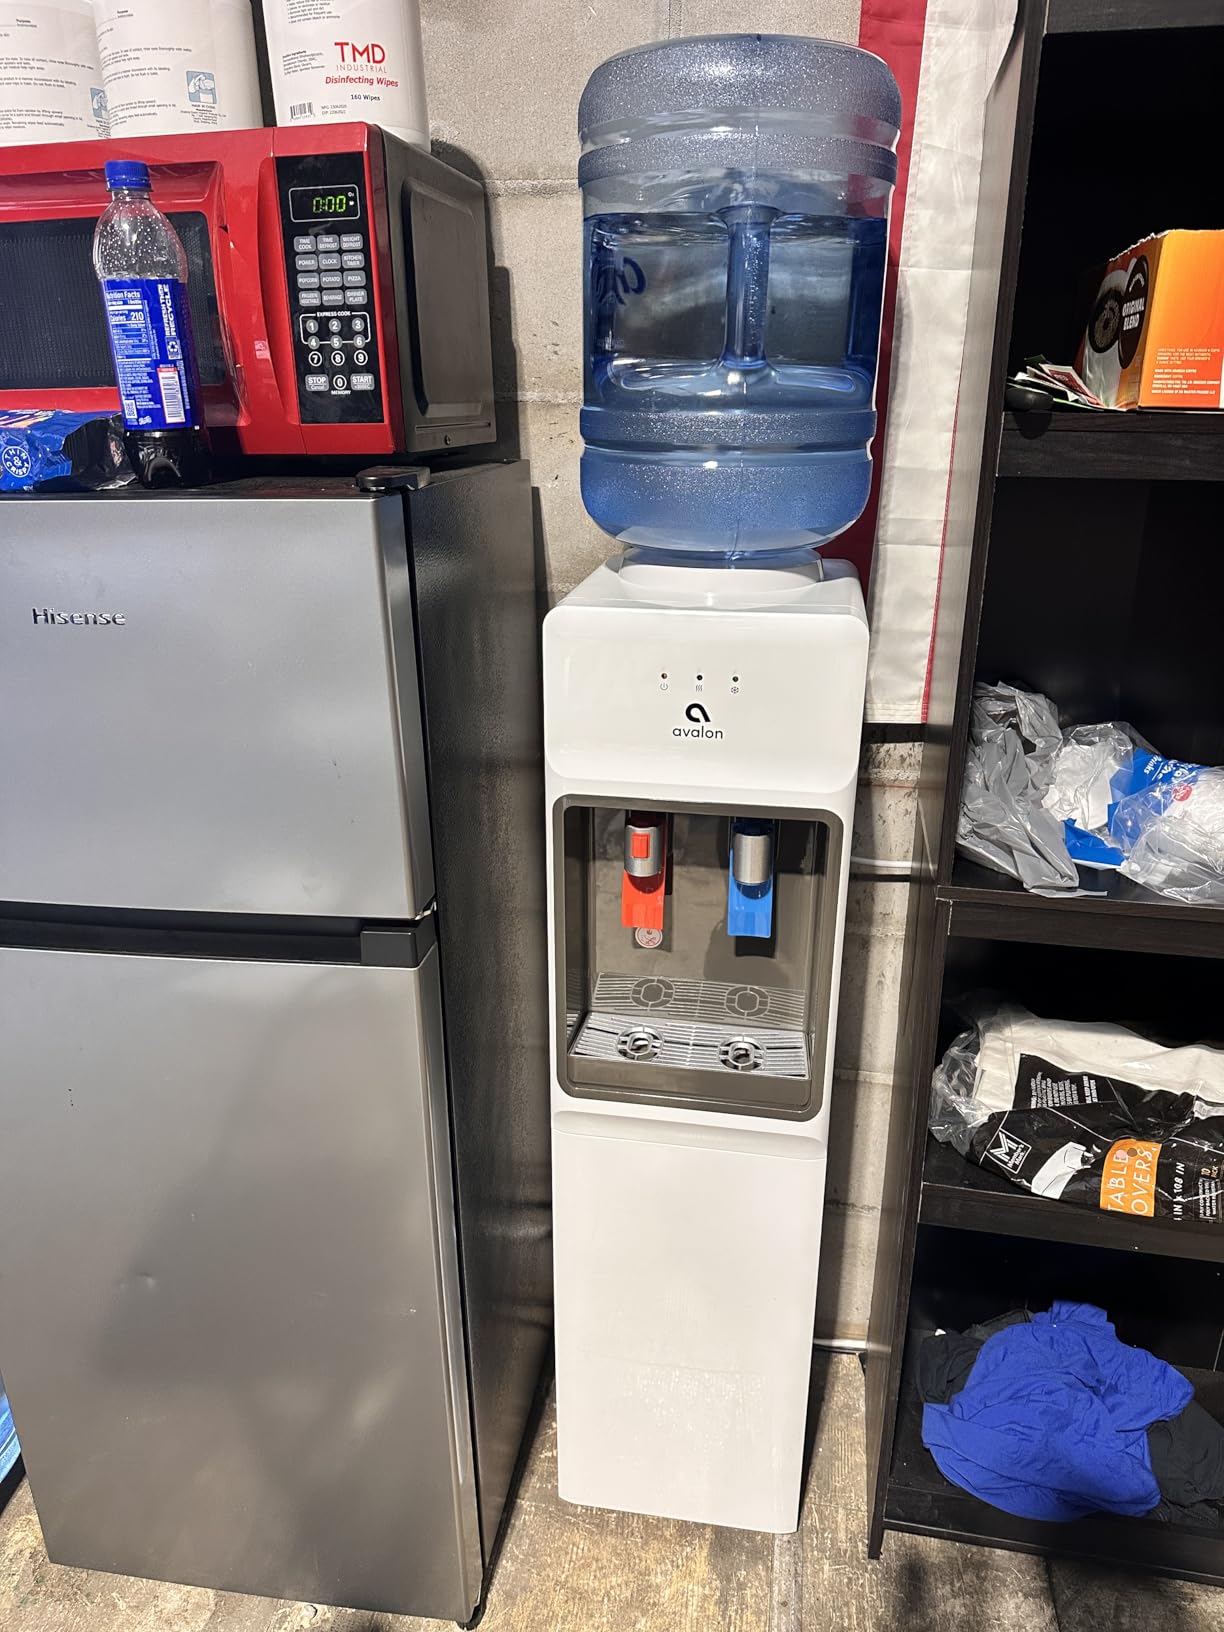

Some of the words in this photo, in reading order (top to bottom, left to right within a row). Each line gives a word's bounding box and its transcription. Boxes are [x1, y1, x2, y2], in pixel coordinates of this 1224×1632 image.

[334, 42, 386, 64] TMD
[336, 64, 387, 73] INDUSTRIAL
[325, 76, 374, 86] Disinfecting
[376, 77, 399, 87] Wipes
[313, 195, 346, 213] 0:00
[1122, 298, 1145, 316] ORIGINAL
[130, 312, 144, 320] 210
[332, 321, 338, 330] 2
[355, 320, 361, 329] 3
[1124, 313, 1140, 330] BLEND
[309, 323, 315, 331] 1
[310, 338, 316, 346] 4
[333, 338, 339, 346] 5
[357, 337, 362, 345] 6
[312, 355, 318, 363] 7
[335, 354, 341, 363] 8
[358, 353, 364, 362] 9
[337, 378, 343, 387] 0
[4, 448, 27, 459] THIN
[14, 456, 22, 466] &
[6, 462, 29, 475] CRISPY
[32, 608, 126, 626] Hisense
[672, 726, 724, 740] avalon
[1007, 1144, 1025, 1169] Member's
[1176, 1162, 1186, 1174] IN
[1200, 1168, 1211, 1176] 10
[1107, 1152, 1129, 1211] TABLE
[1174, 1176, 1184, 1193] 108
[1174, 1202, 1183, 1216] IN
